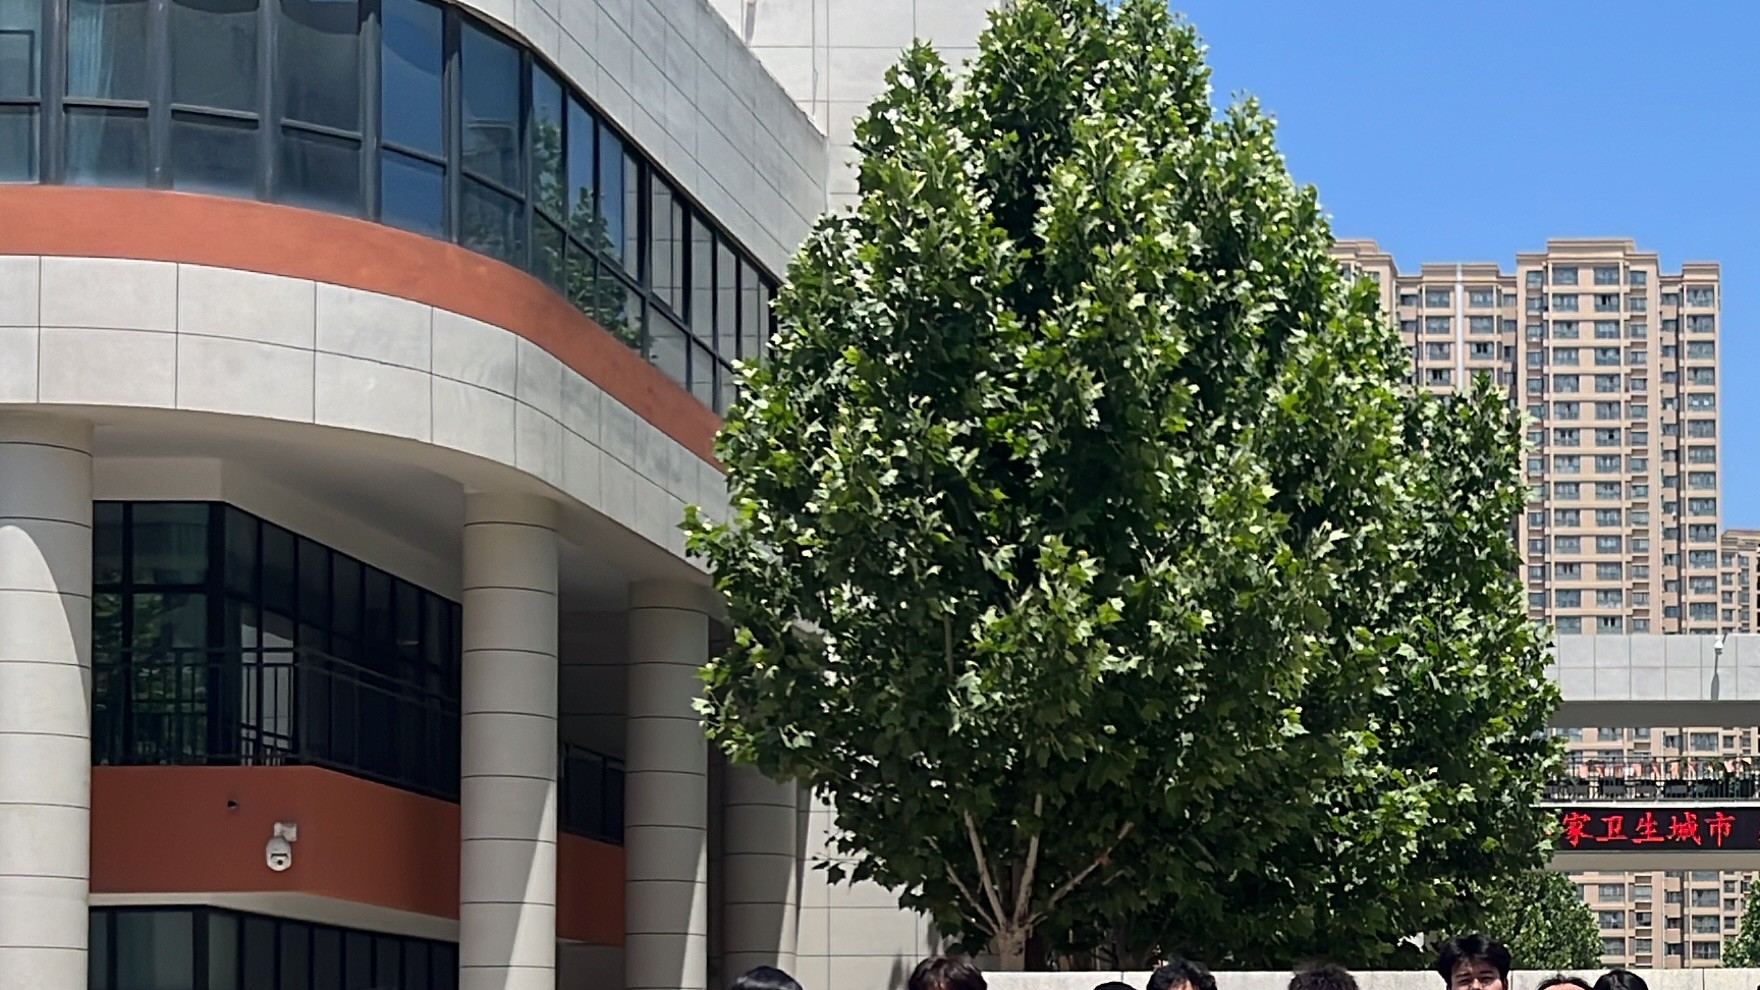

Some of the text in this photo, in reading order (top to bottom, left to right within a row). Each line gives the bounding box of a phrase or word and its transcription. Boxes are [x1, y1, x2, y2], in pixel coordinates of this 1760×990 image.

[1562, 811, 1735, 848] 家卫生城市
